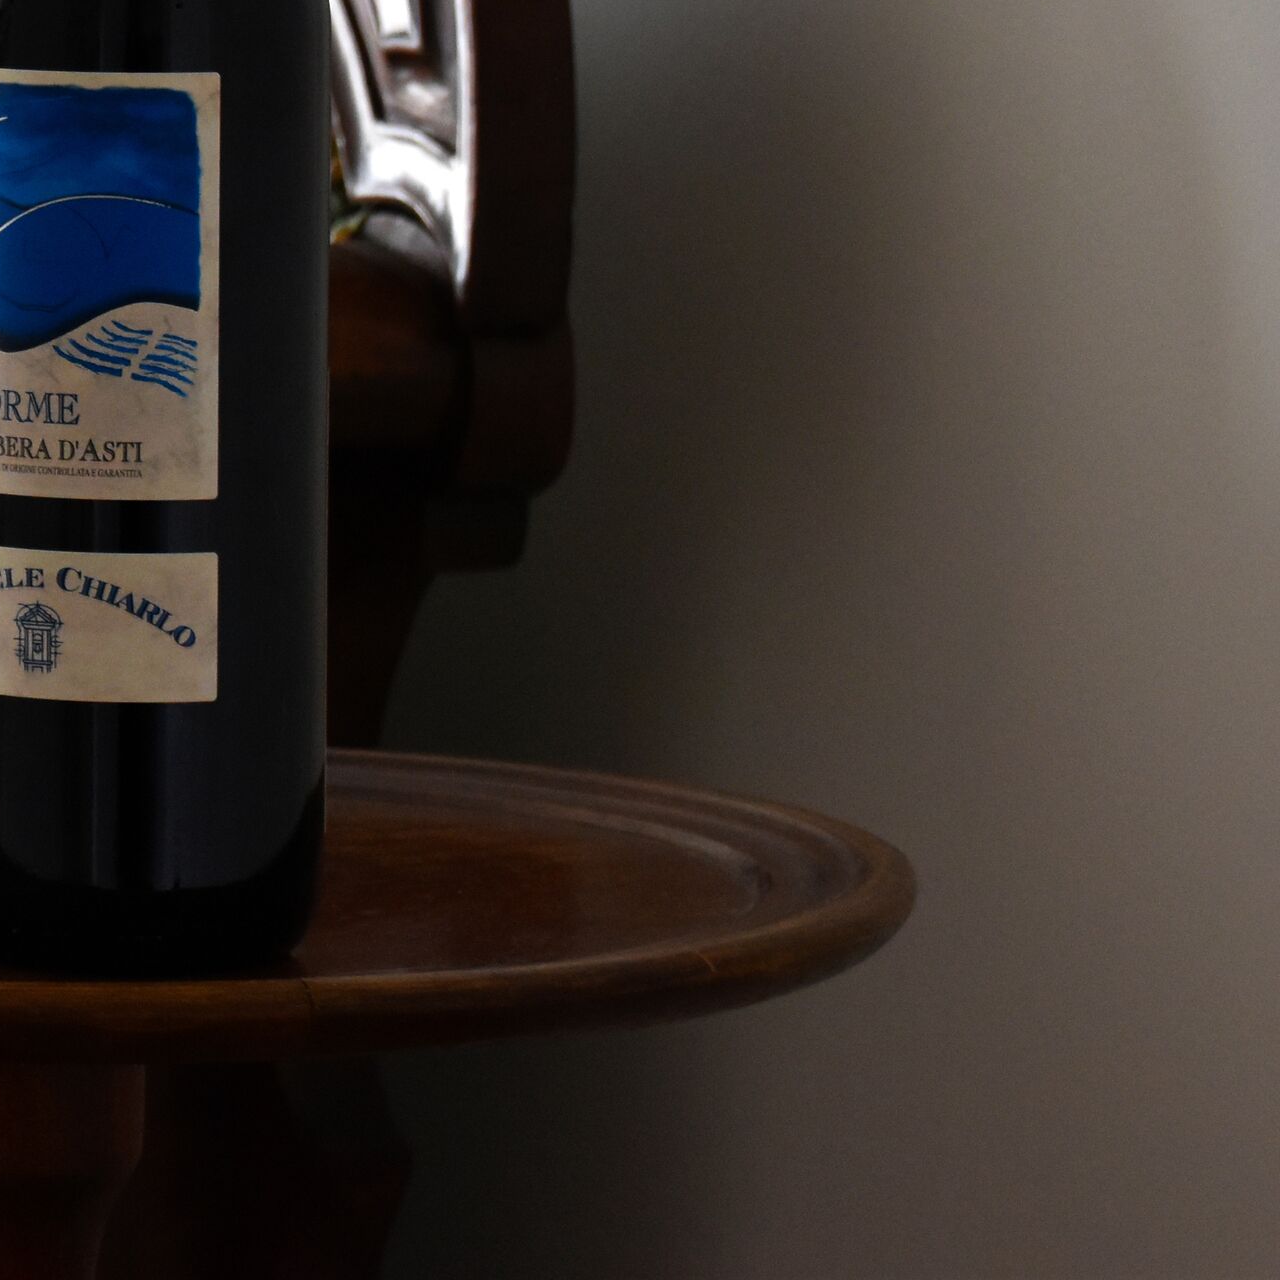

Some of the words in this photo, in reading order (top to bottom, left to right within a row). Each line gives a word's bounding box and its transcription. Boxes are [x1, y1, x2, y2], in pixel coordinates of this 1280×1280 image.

[58, 438, 143, 463] D'ASTI
[37, 465, 90, 477] CONTROLLATA
[97, 468, 142, 479] GARANTITA
[55, 567, 197, 648] CHIARLO
